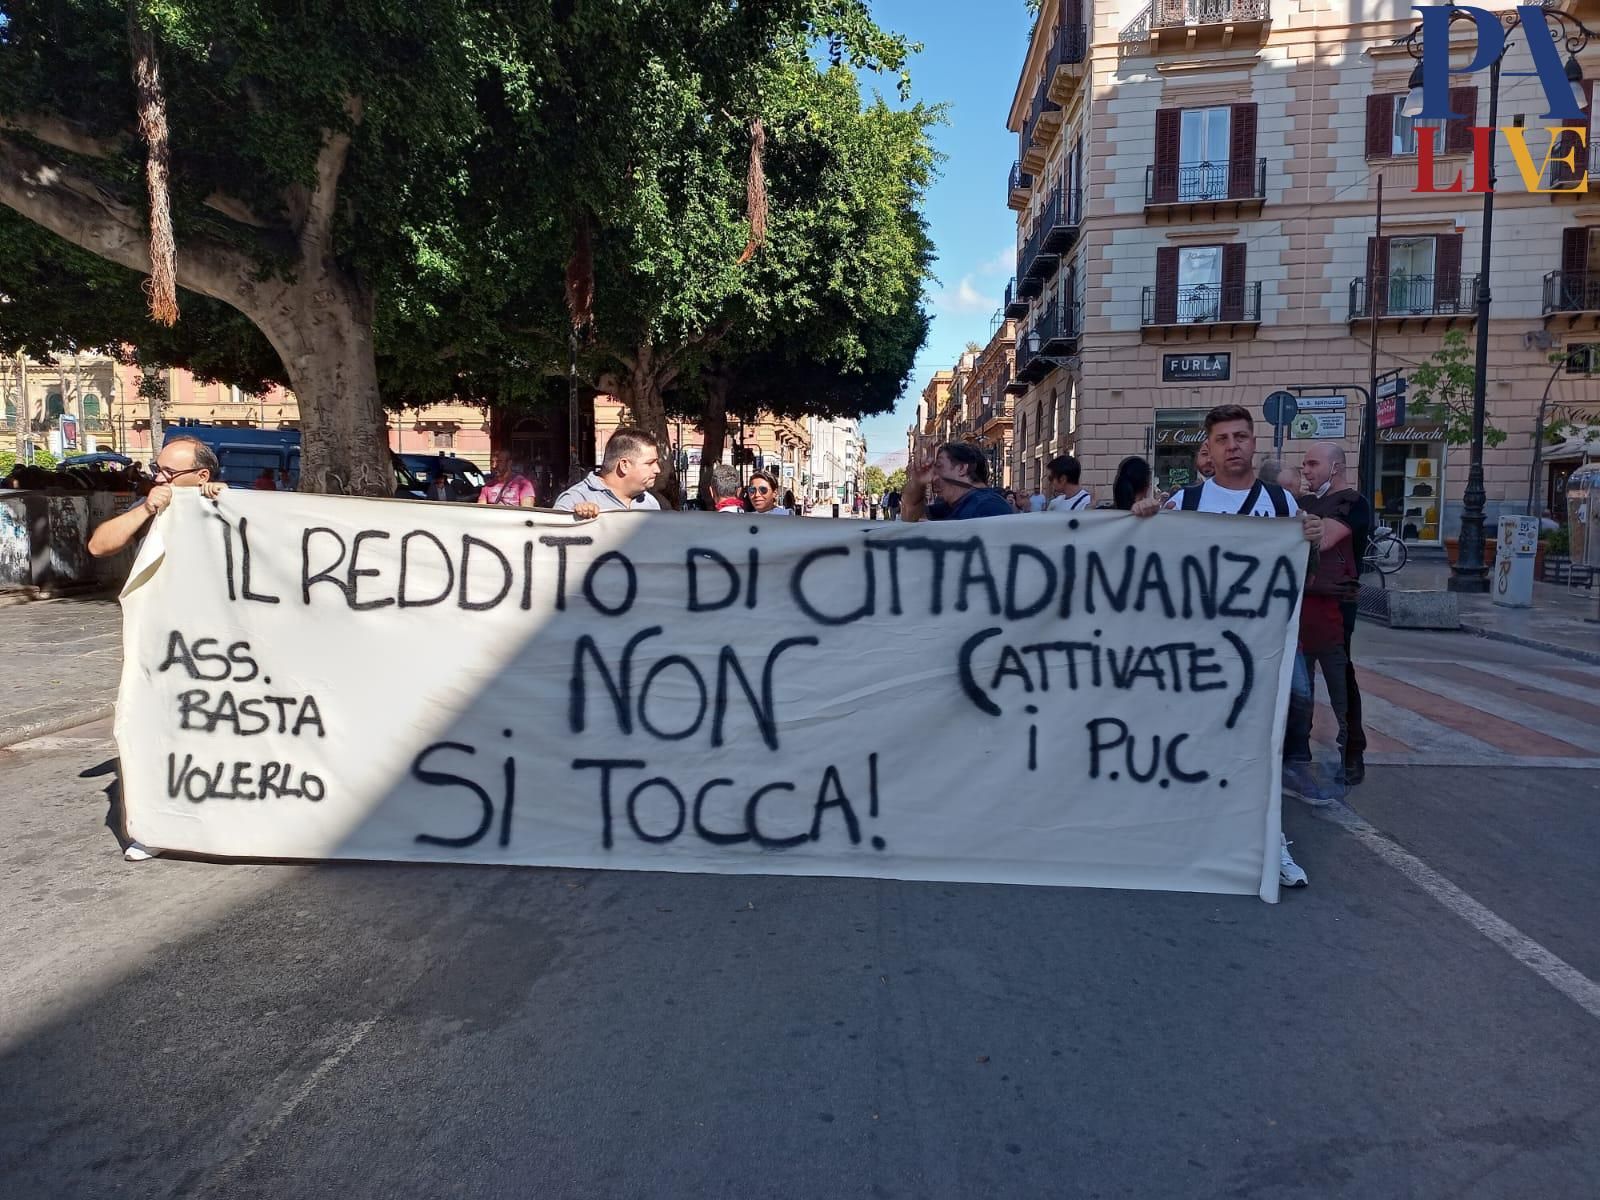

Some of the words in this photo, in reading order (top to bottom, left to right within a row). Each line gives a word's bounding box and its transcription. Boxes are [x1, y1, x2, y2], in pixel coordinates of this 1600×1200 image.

[1170, 359, 1222, 371] FURLA
[159, 629, 272, 685] ASS.
[178, 689, 325, 738] BASTA
[568, 625, 819, 752] NON
[167, 752, 325, 803] VOLERLO
[1085, 717, 1229, 789] P.U.C.
[571, 752, 887, 851] TOCCA!
